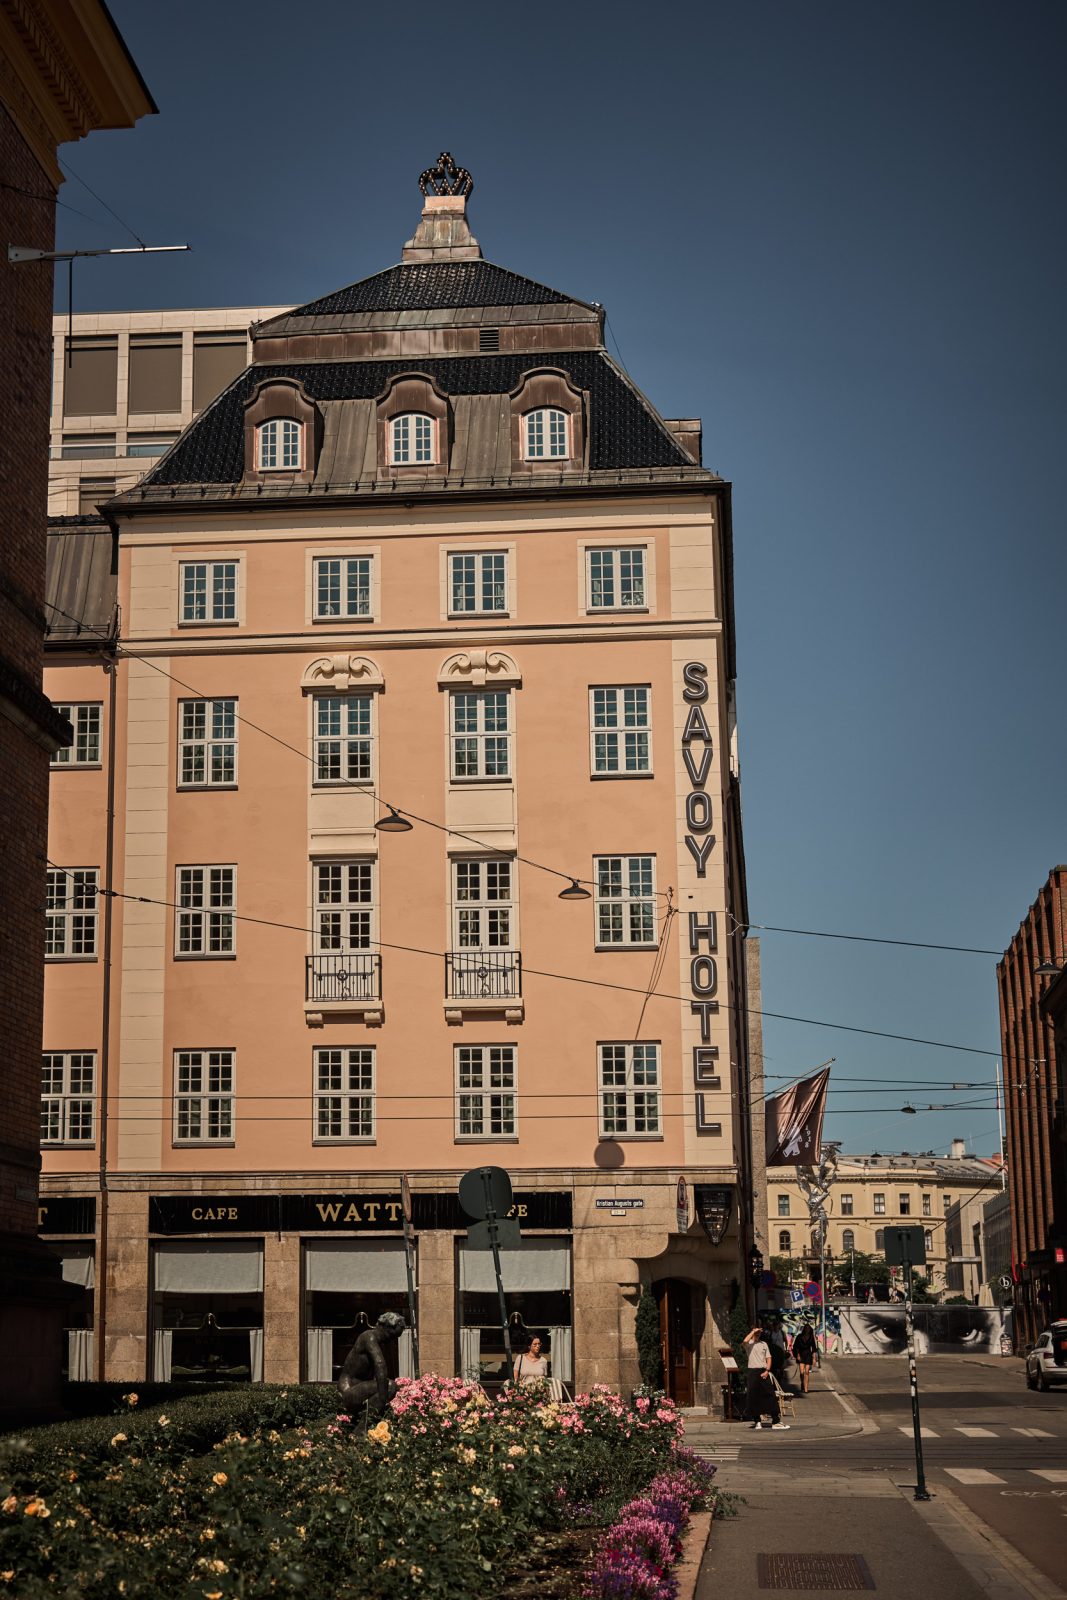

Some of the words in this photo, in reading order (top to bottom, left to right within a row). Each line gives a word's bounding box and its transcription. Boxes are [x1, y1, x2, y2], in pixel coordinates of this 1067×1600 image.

[681, 661, 717, 875] SAVOY
[688, 911, 722, 1133] HOTEL
[191, 1207, 238, 1220] CAFE
[315, 1202, 402, 1223] WATT
[506, 1204, 528, 1217] FE
[793, 1291, 800, 1301] P
